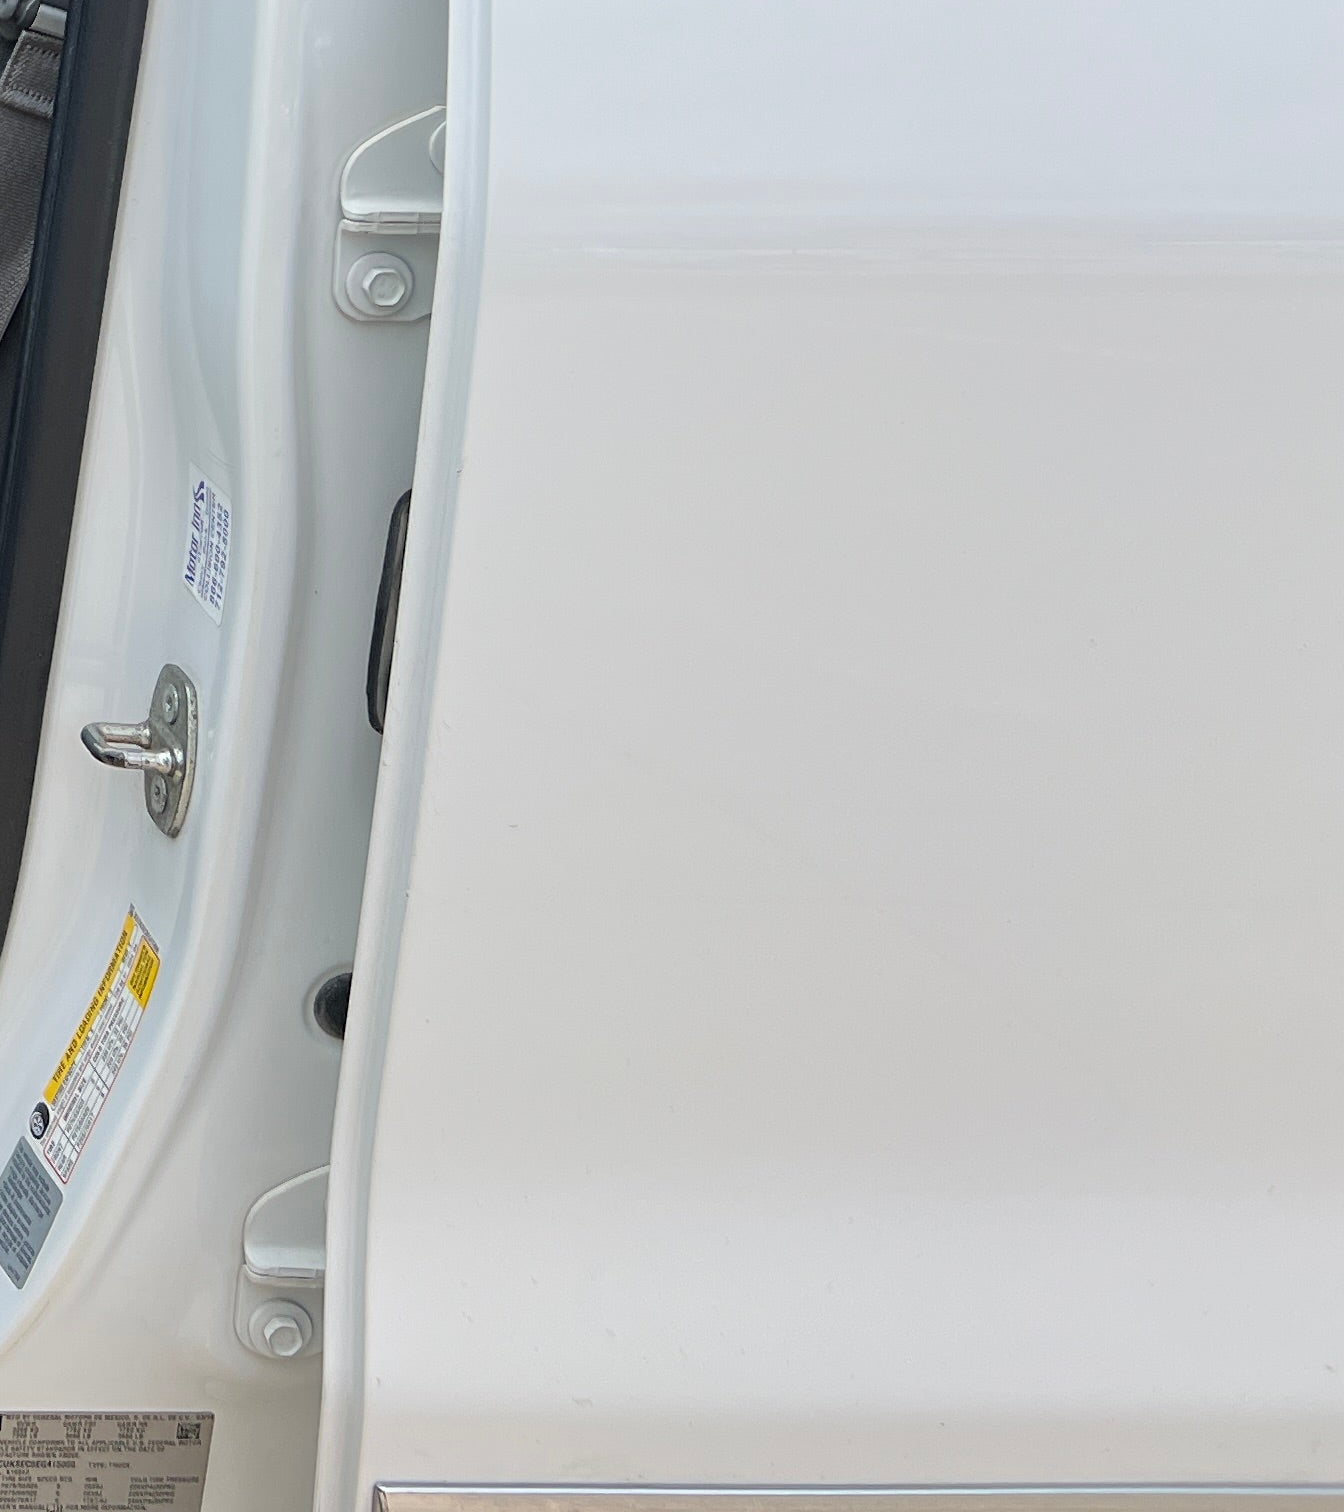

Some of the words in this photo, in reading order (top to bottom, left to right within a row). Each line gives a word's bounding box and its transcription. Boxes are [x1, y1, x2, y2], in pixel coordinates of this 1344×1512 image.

[184, 532, 199, 586] Motor
[192, 502, 201, 532] Inn
[51, 1062, 67, 1084] TIRE
[65, 1039, 78, 1063] AND
[75, 996, 99, 1040] LOADING
[98, 928, 129, 997] INFORMATION
